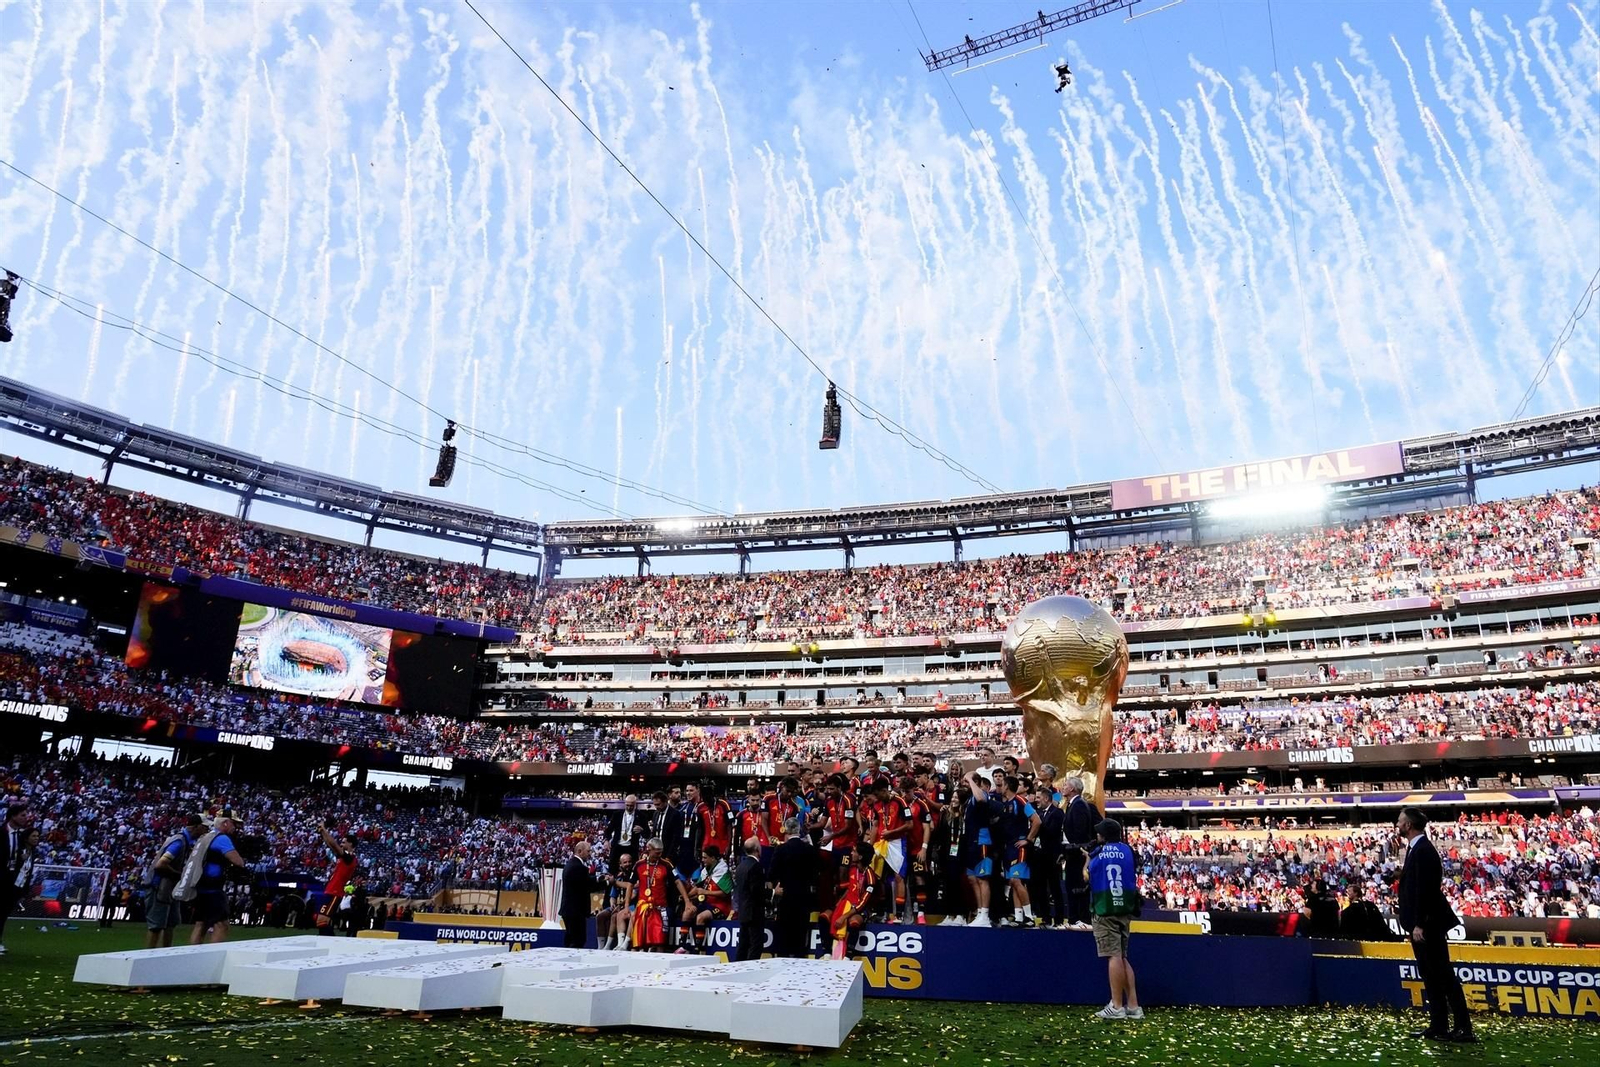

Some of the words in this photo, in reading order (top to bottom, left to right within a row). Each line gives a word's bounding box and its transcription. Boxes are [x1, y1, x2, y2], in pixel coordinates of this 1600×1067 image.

[1143, 469, 1226, 501] THE
[1233, 451, 1366, 490] FINAL
[1470, 592, 1488, 600] FIFA
[1489, 590, 1518, 599] WORLD
[1520, 587, 1536, 595] CUP
[1538, 583, 1568, 593] 2026
[1572, 580, 1592, 589] THE
[291, 598, 357, 618] #FIFAWorldCup
[1208, 799, 1258, 807] THE
[1263, 797, 1342, 806] FINAL
[841, 855, 850, 865] 16
[1099, 851, 1125, 860] PHOTO
[437, 929, 455, 938] FIFA
[456, 929, 486, 940] WORLD
[488, 930, 505, 940] CUP
[506, 932, 538, 942] 2026
[855, 931, 923, 954] 026
[1453, 966, 1512, 983] ORLD
[1514, 969, 1554, 985] CUP
[1401, 980, 1489, 1011] TE
[1495, 984, 1600, 1017] FINA
